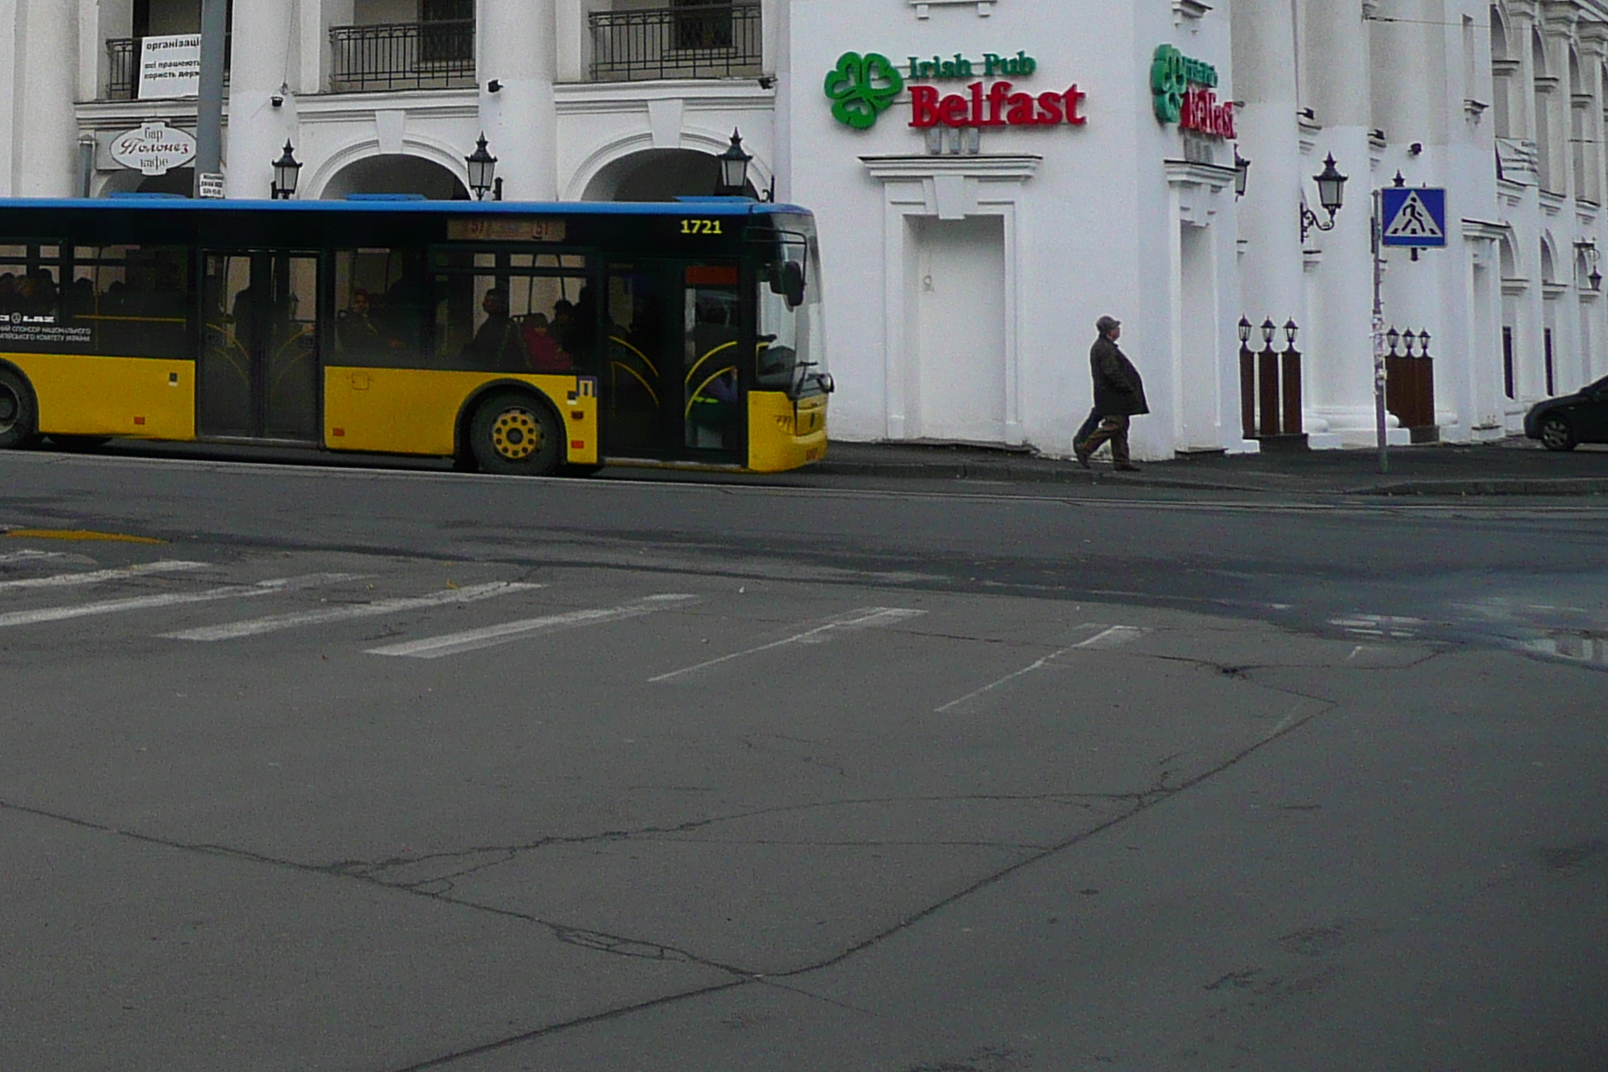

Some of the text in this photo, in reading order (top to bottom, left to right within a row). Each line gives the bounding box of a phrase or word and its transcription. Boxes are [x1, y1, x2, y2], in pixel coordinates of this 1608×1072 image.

[907, 50, 1037, 79] Irish Pub
[907, 81, 1087, 128] Belfast
[145, 126, 163, 142] бар
[118, 137, 188, 155] Полонез
[140, 155, 169, 170] кафе
[680, 219, 722, 234] 1721
